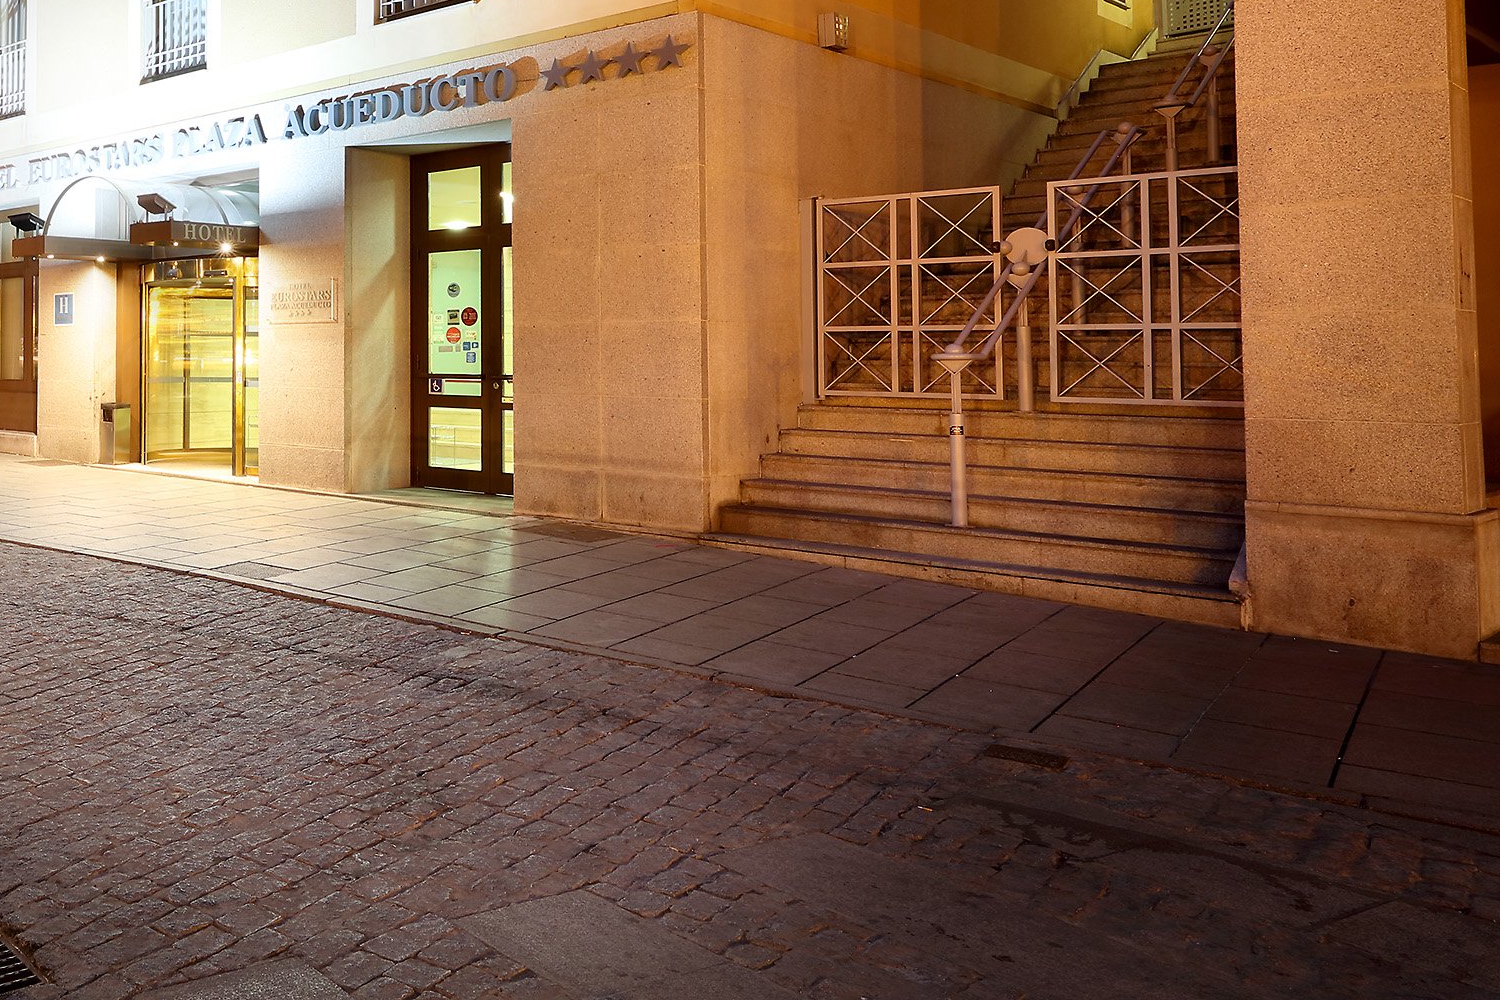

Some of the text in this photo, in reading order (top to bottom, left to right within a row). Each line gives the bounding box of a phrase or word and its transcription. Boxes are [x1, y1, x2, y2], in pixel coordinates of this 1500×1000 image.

[28, 134, 164, 186] EUROSTARS
[172, 114, 267, 158] PLAZA
[282, 67, 517, 139] ACUEDUCTO
[184, 223, 246, 243] HOTEL
[272, 289, 332, 302] EUROSTARS
[59, 297, 69, 314] H
